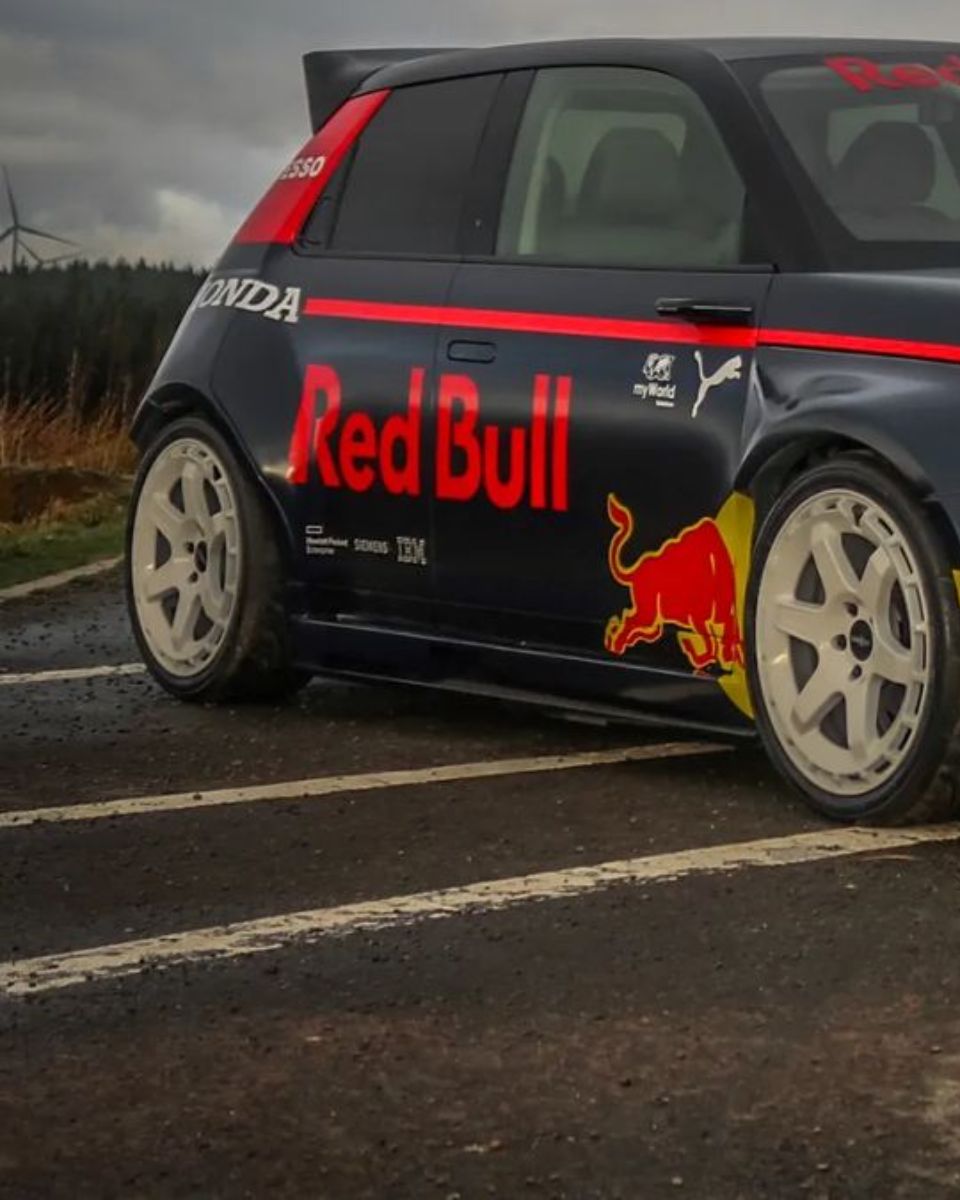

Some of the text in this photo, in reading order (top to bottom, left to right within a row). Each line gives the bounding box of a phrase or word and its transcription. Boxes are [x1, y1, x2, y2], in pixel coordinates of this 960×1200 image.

[198, 278, 301, 323] ONDA
[285, 363, 572, 512] Red Bull
[396, 536, 427, 565] IBM
